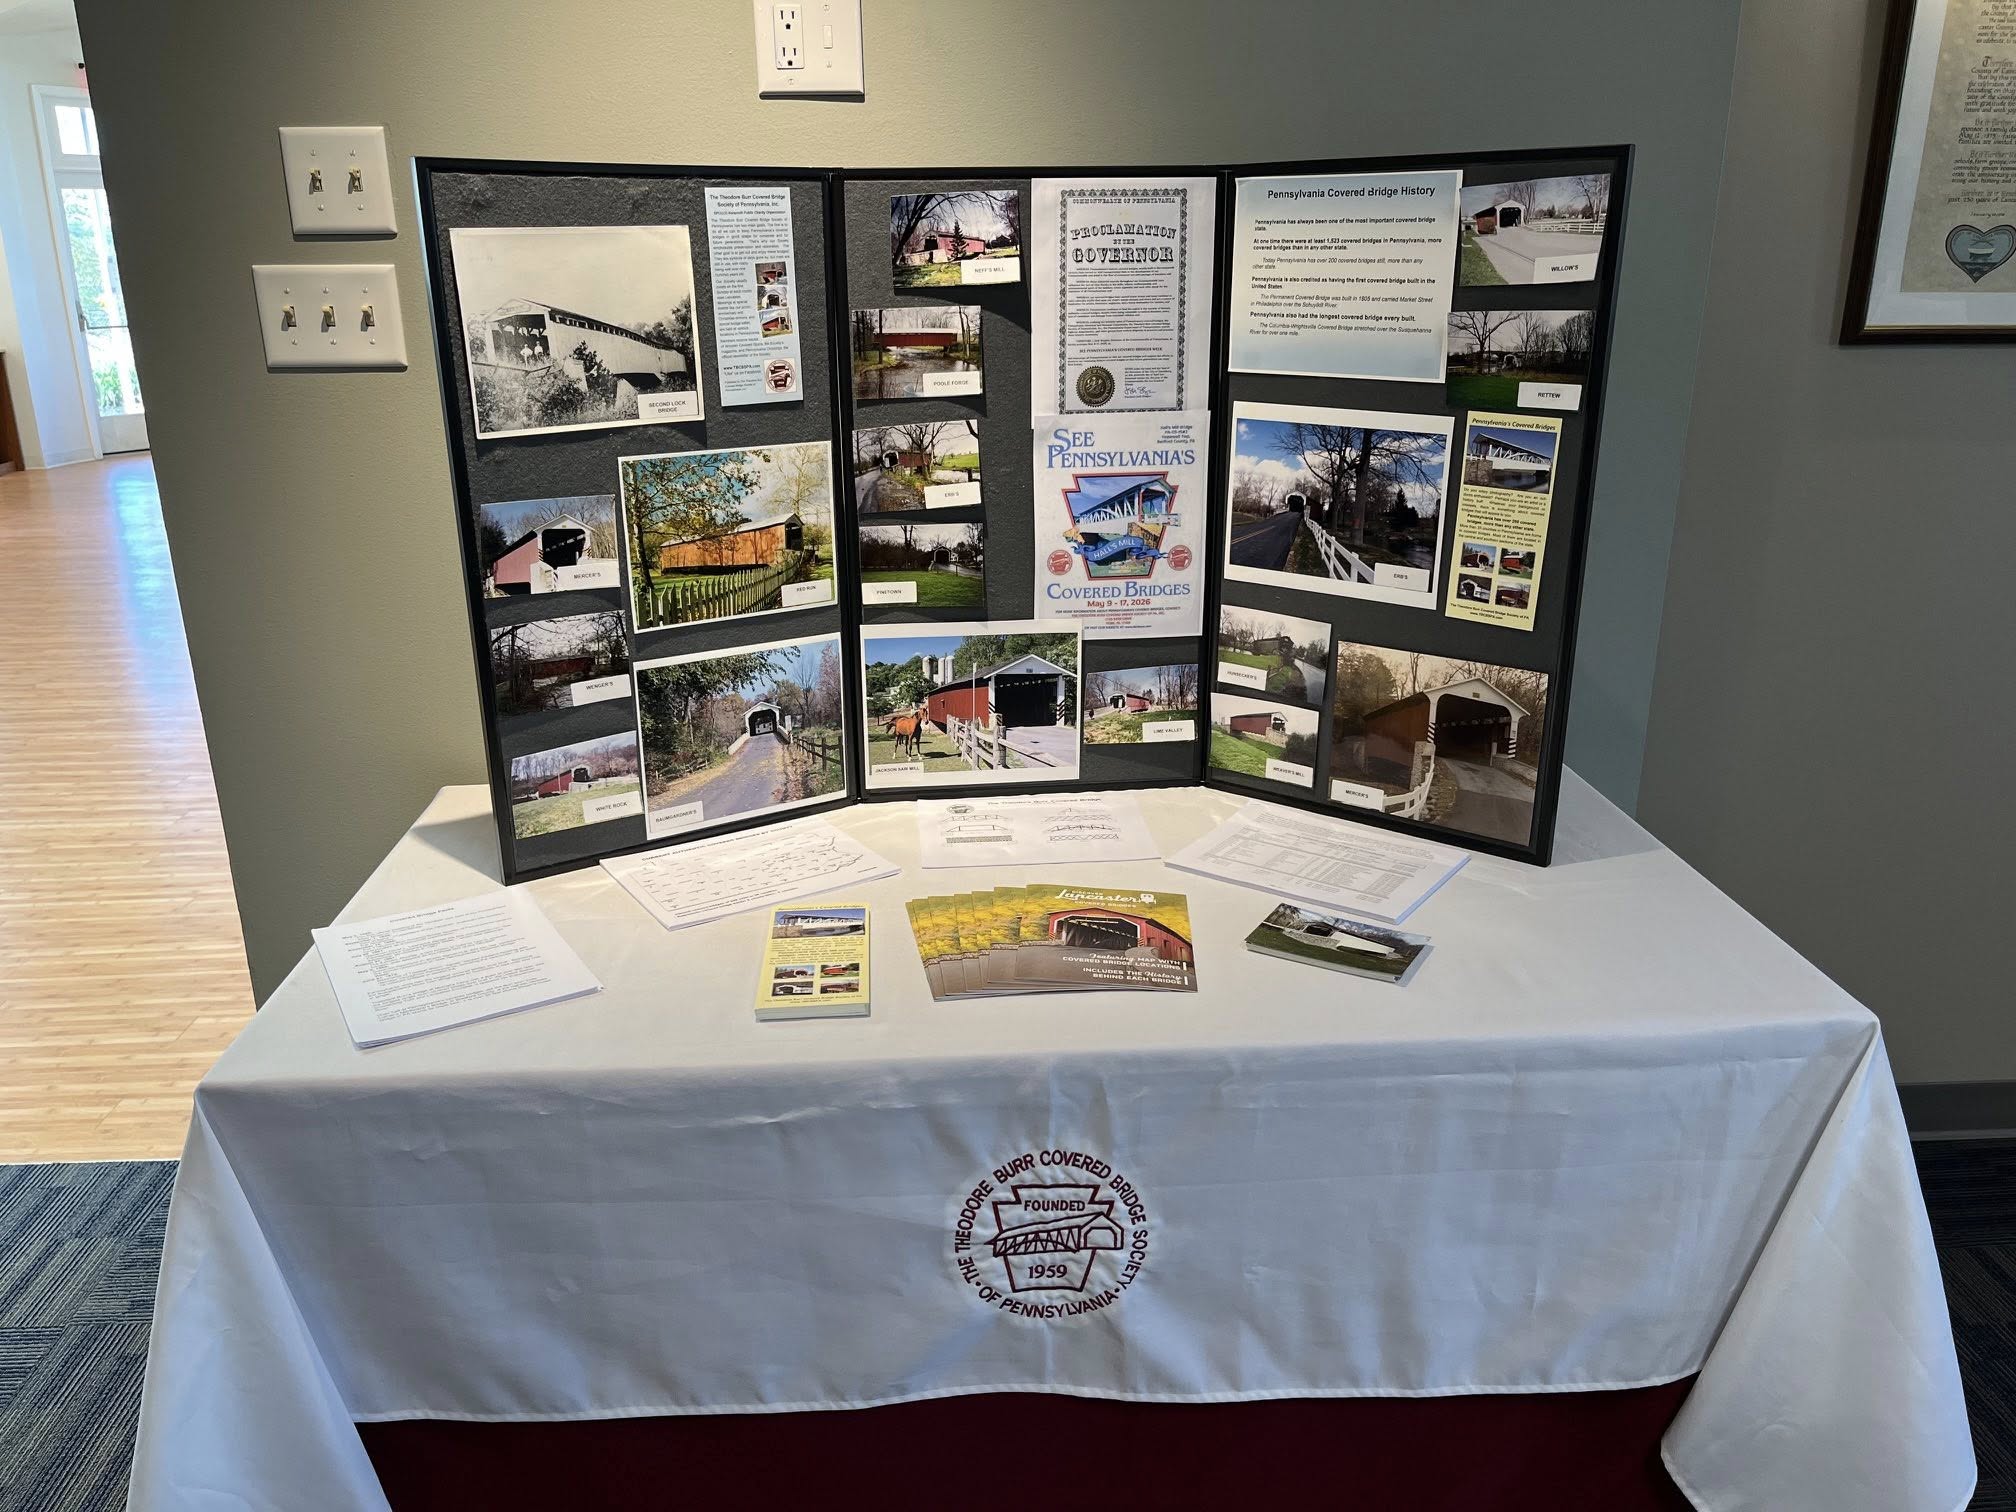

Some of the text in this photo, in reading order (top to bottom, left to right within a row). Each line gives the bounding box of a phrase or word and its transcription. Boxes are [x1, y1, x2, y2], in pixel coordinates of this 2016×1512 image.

[1268, 186, 1435, 200] Pennsylvania Covered Bridge History
[1070, 224, 1177, 240] PROCLAMATION
[1072, 247, 1174, 263] GOVERNOR
[1551, 264, 1579, 272] WILLOW'S
[1512, 421, 1534, 429] Covered
[1535, 423, 1556, 431] Bridges
[1053, 428, 1095, 452] SEE
[1047, 445, 1195, 469] PENNSYLVANIA'S
[1094, 539, 1135, 558] HALL'S MILL
[1047, 581, 1191, 599] COVERED BRIDGES
[1088, 600, 1105, 608] May
[1120, 599, 1128, 607] 17,
[1130, 598, 1151, 606] 2026
[586, 682, 614, 690] WENGER'S
[1346, 790, 1368, 798] MERCER'S
[596, 804, 612, 812] WHITE
[656, 810, 697, 823] BAUMGARDNER'S
[1055, 889, 1139, 904] Lancaster
[1062, 956, 1101, 965] COVERED
[1135, 961, 1181, 970] LOCATIONS
[1089, 953, 1134, 962] Featuring
[1144, 971, 1182, 980] History
[1024, 1200, 1086, 1212] FOUNDED
[954, 1149, 1149, 1290] THE THEODORE BURR COVERED BRIDGE SOCIETY
[1028, 1264, 1068, 1279] 1959
[978, 1285, 1119, 1319] OF PENNSYLVANIA
